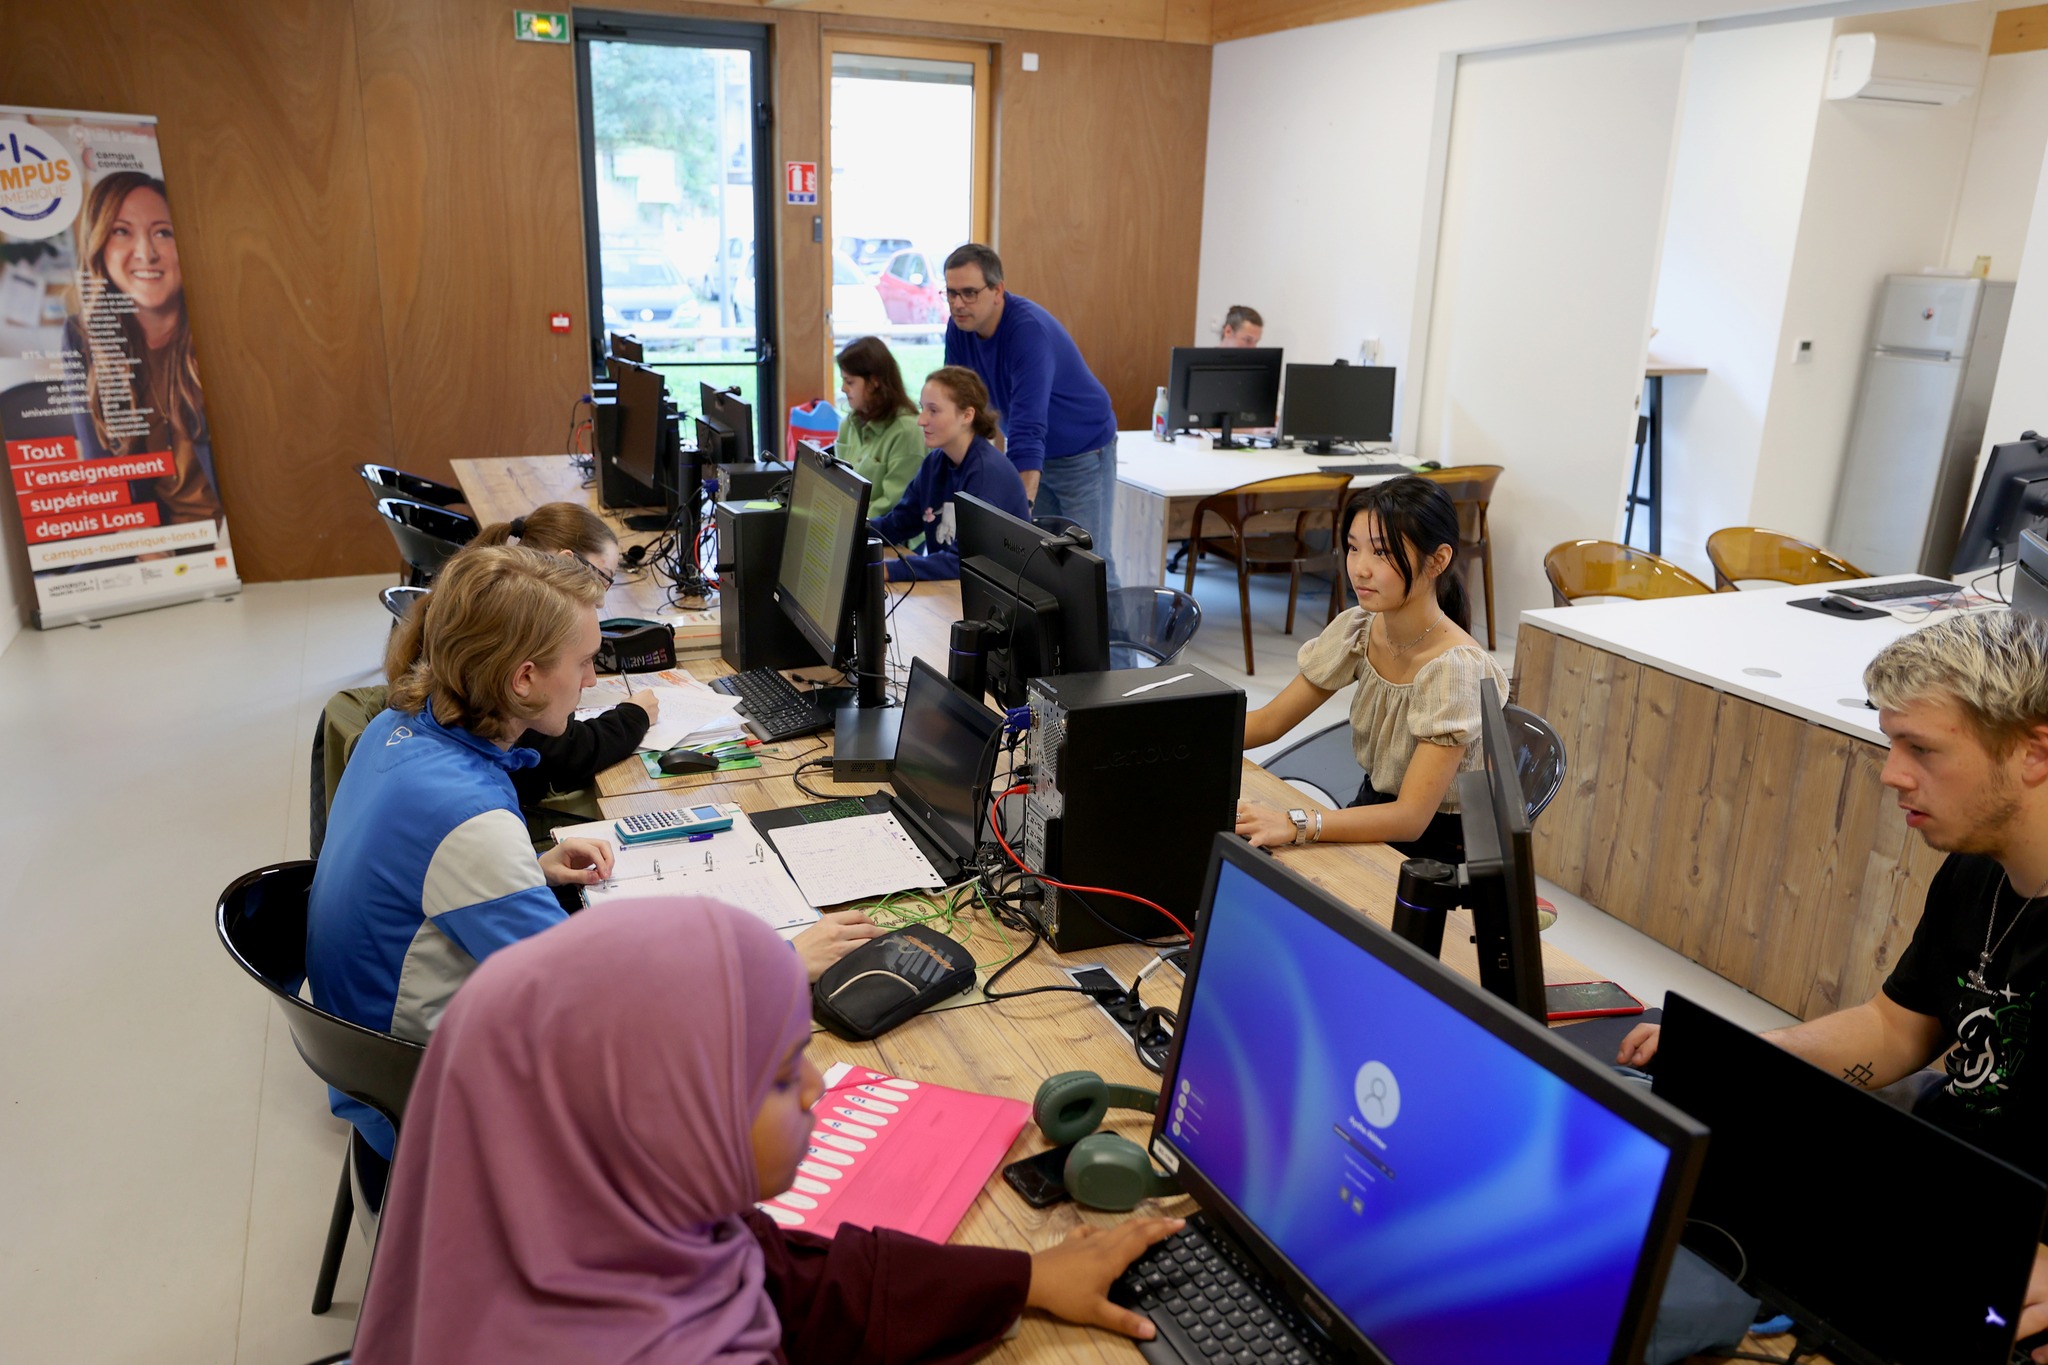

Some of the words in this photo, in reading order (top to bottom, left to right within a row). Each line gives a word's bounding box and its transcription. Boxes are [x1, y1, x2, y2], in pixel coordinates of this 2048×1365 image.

[0, 159, 71, 191] MPUS
[46, 385, 60, 393] en
[18, 442, 66, 461] Tout
[24, 458, 165, 487] l'enseignement
[30, 489, 118, 514] supérieur
[36, 515, 99, 538] depuis
[102, 510, 145, 529] Lons
[42, 528, 209, 563] campus-numerique-lons.fr
